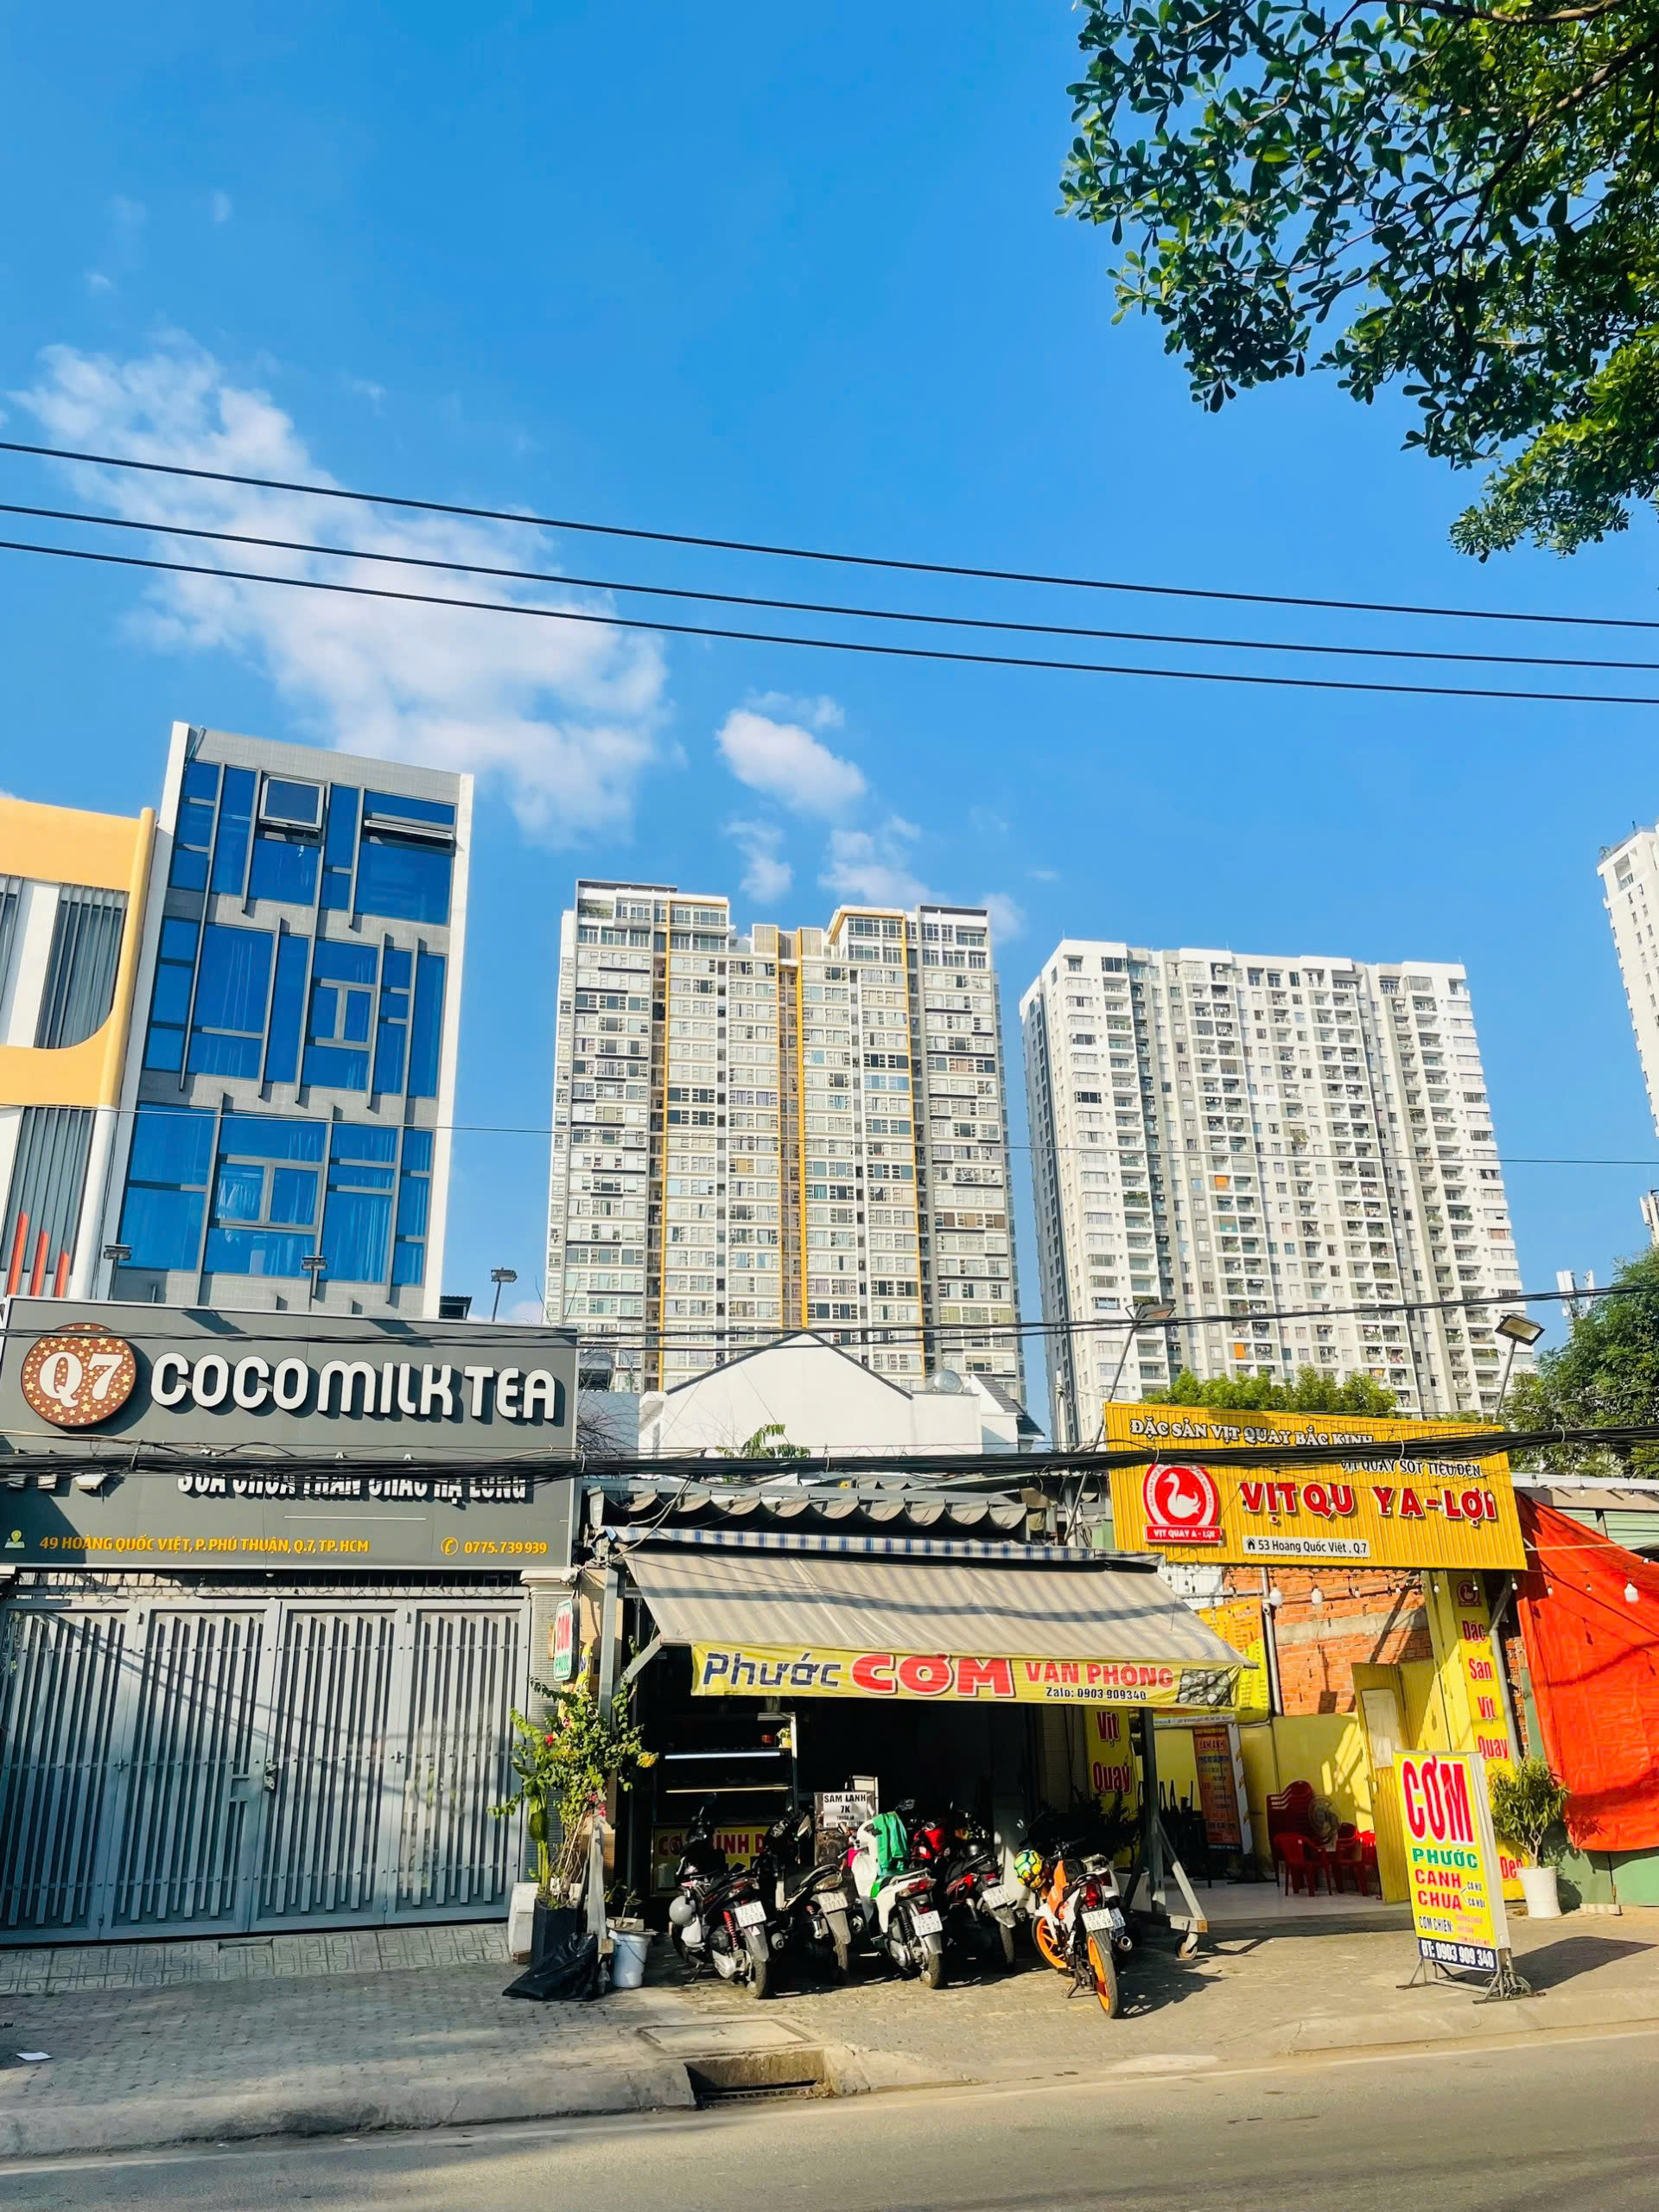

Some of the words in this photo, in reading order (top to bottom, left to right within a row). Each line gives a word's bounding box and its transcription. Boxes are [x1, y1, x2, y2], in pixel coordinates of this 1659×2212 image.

[39, 1351, 123, 1406] Q7
[463, 1366, 555, 1420] TEA
[1130, 1416, 1169, 1439] ĐẶC
[1171, 1417, 1209, 1439] SẢN
[1210, 1424, 1241, 1444] VỊT
[1243, 1426, 1292, 1446] QUAY
[40, 1536, 59, 1549] 49
[62, 1535, 113, 1550] HOÀNG
[116, 1535, 155, 1553] QUỐC
[157, 1536, 194, 1554] VIỆT,
[241, 1536, 292, 1554] THUẬN,
[1258, 1539, 1270, 1550] 53
[1272, 1540, 1301, 1553] Hoàng
[1304, 1541, 1326, 1553] Quốc
[1353, 1542, 1367, 1554] Q.7
[702, 1651, 841, 1687] Phước
[850, 1652, 1015, 1697] CƠM
[1046, 1687, 1075, 1698] Zalo:
[1077, 1688, 1103, 1700] 0903
[1478, 1735, 1508, 1759] Quay
[1403, 1755, 1474, 1843] CƠM
[1412, 1847, 1478, 1869] PHƯỚC
[1414, 1868, 1462, 1889] CANH
[1417, 1890, 1463, 1911] CHUA
[1435, 1942, 1458, 1961] 0903
[1458, 1945, 1476, 1965] 909
[1476, 1949, 1494, 1968] 340
